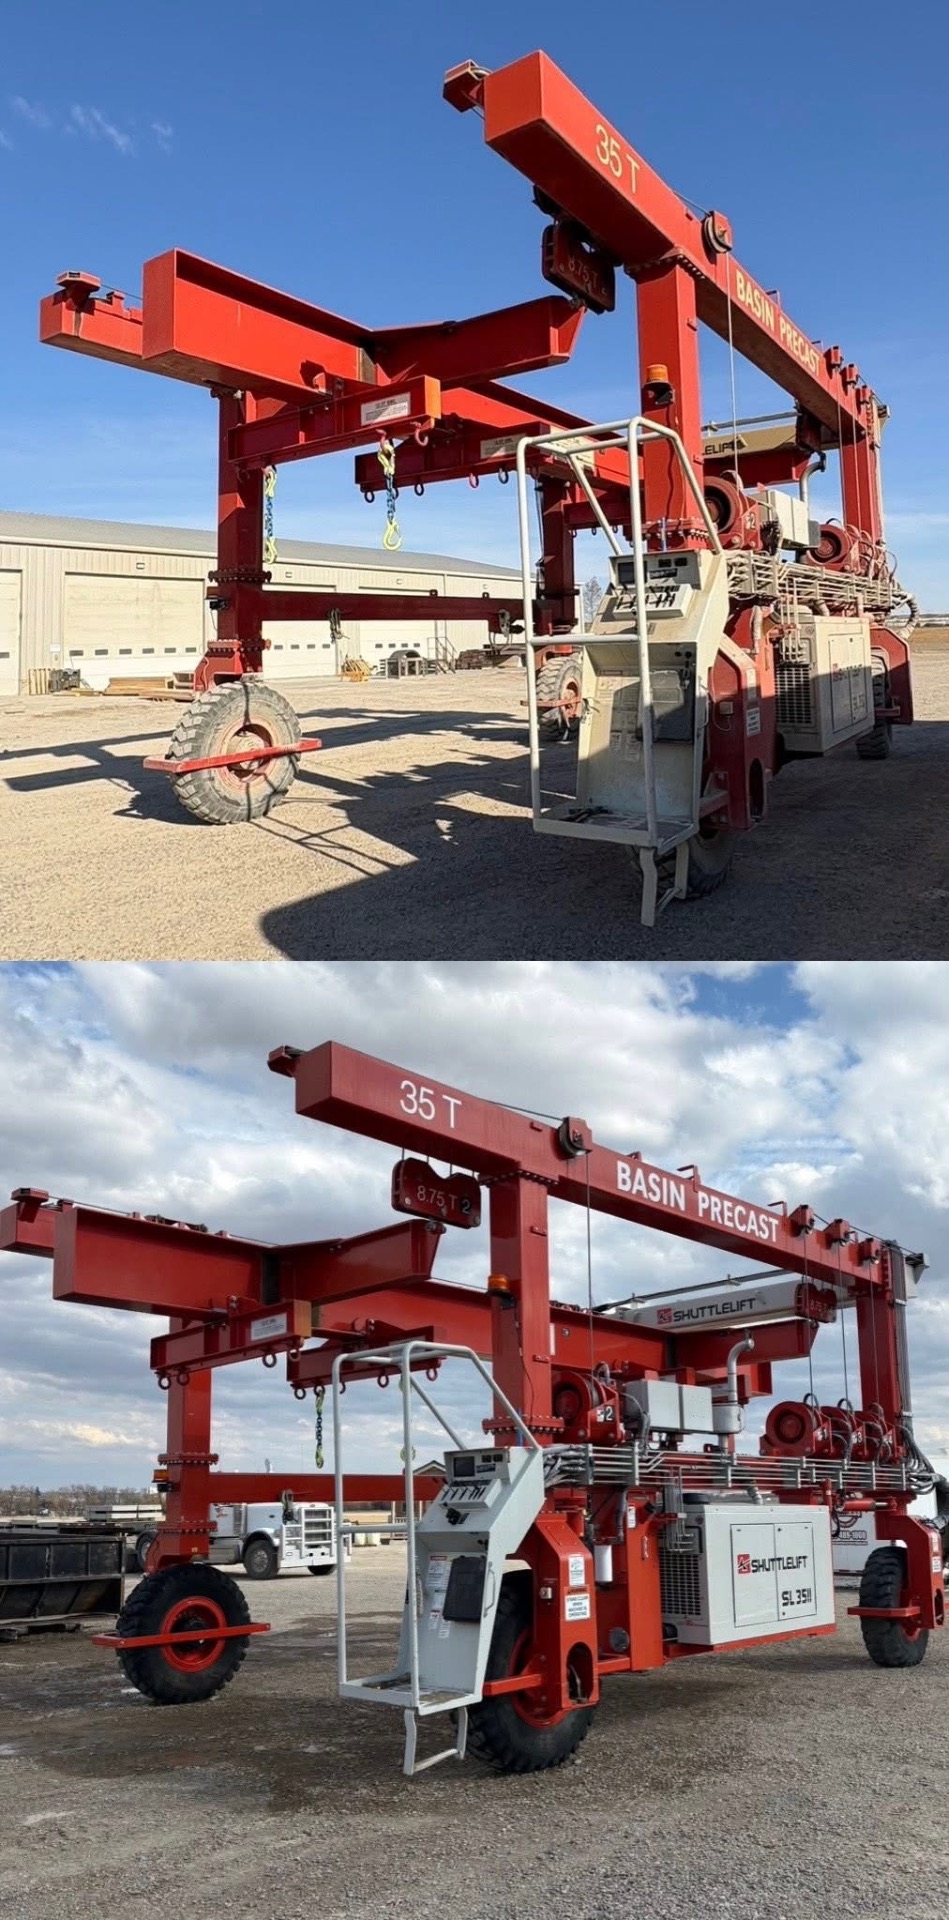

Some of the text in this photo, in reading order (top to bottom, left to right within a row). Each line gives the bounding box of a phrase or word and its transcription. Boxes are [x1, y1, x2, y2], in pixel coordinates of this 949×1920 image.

[596, 124, 640, 193] 35 T
[736, 269, 820, 376] BASIN PRECAST
[400, 1080, 462, 1128] 35 T
[417, 1185, 471, 1215] 8.75 T 2
[617, 1160, 778, 1242] BASIN PRECAST
[673, 1298, 756, 1322] SHUTTLELIFT
[605, 1405, 613, 1421] 2
[751, 1555, 808, 1573] SHUTTLELIFT
[781, 1591, 795, 1606] SL
